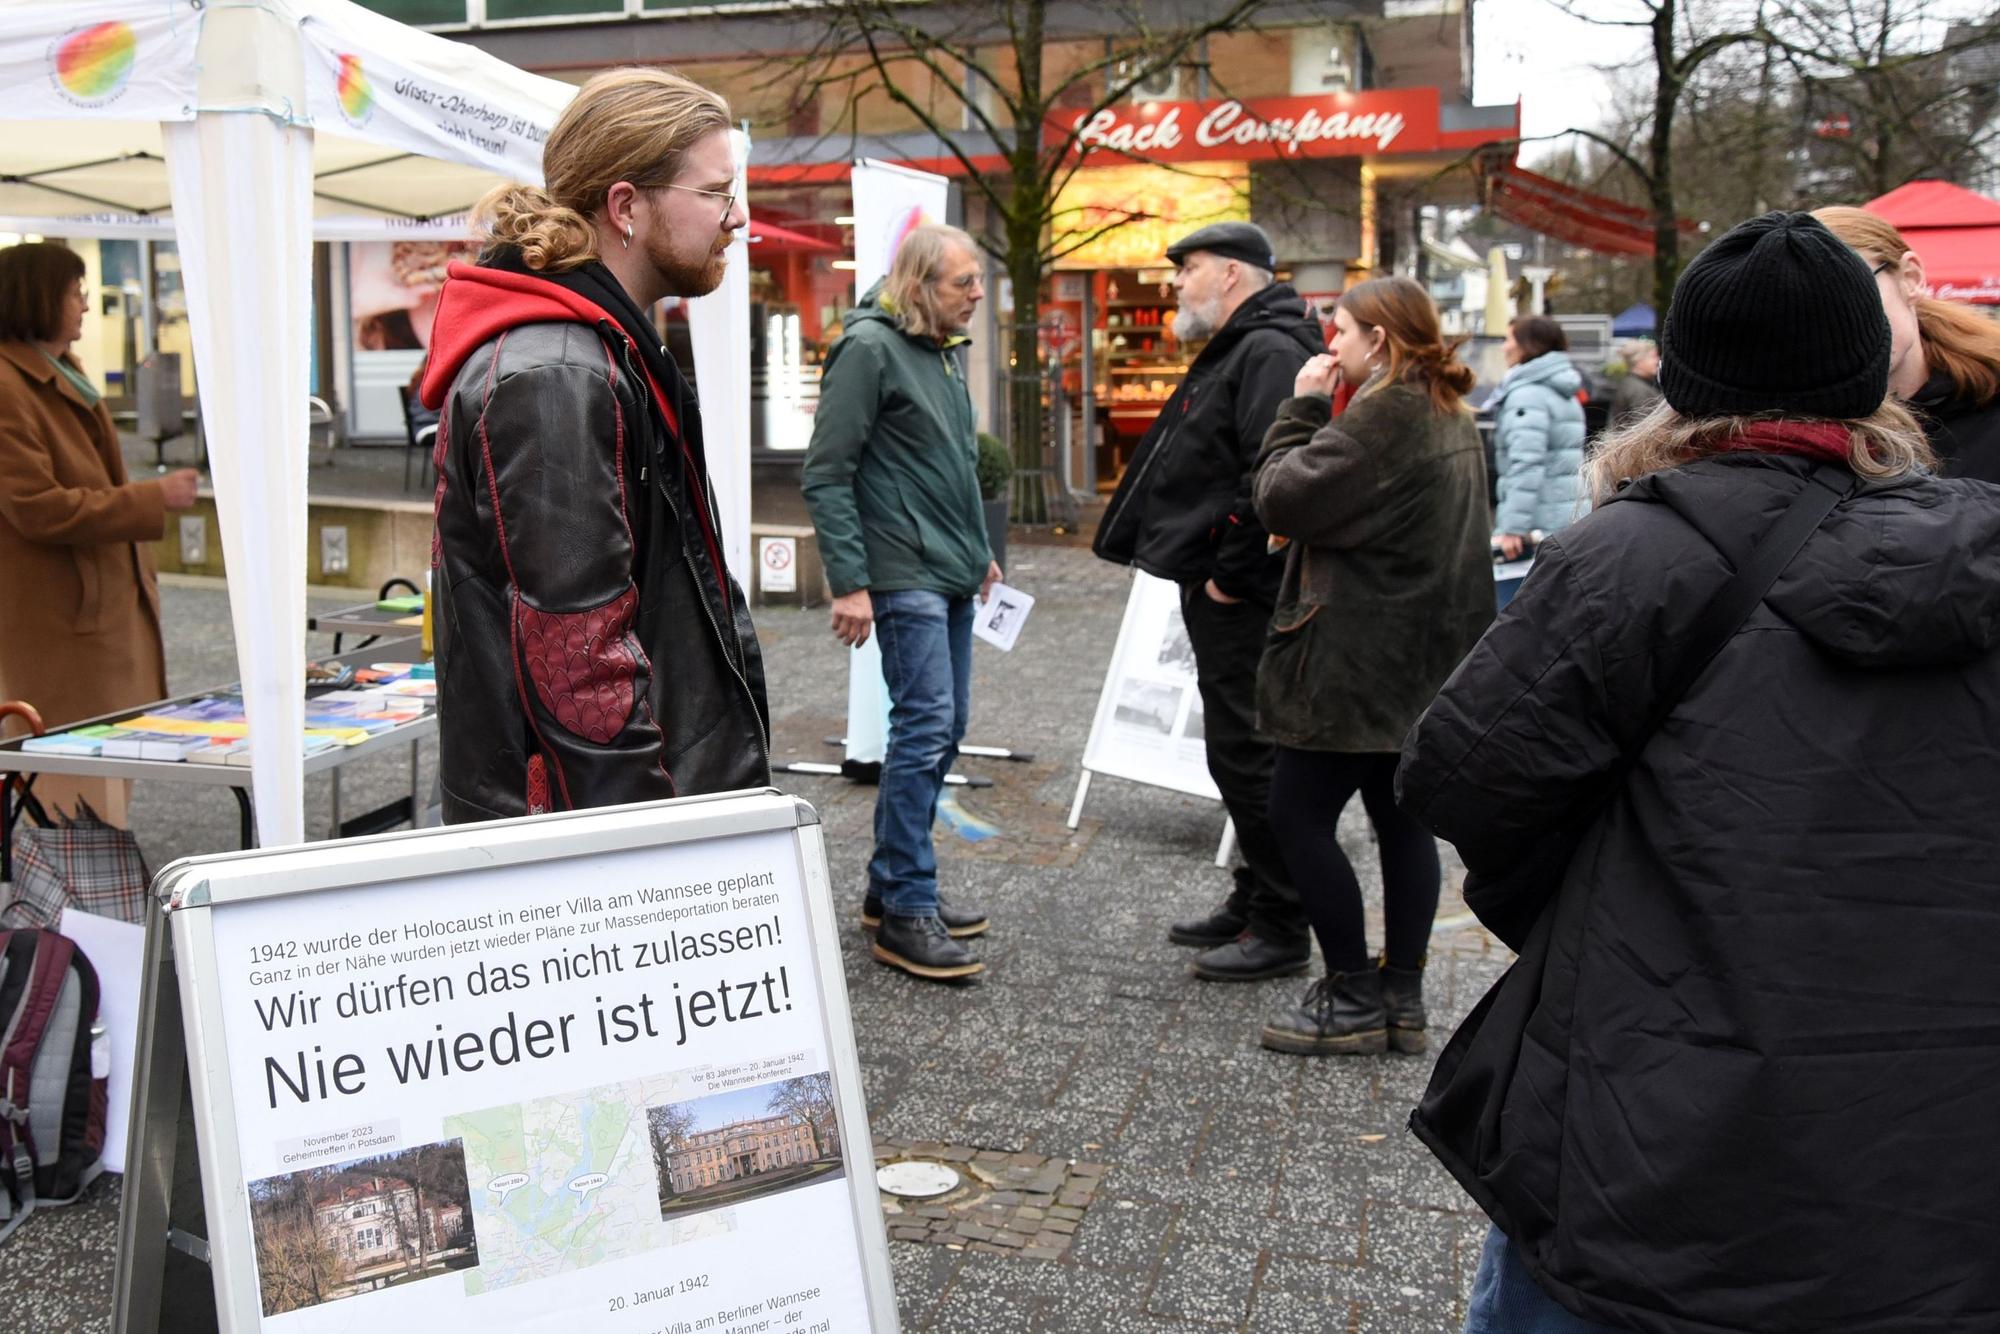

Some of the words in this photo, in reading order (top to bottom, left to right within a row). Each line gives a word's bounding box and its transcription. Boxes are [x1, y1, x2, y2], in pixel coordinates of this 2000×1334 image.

[526, 121, 550, 144] bun
[1195, 100, 1406, 154] Company
[250, 940, 298, 964] 1942
[303, 932, 362, 956] wurde
[368, 927, 398, 947] der
[404, 912, 494, 941] Holocaust
[498, 908, 515, 926] in
[519, 903, 562, 923] einer
[566, 896, 604, 916] Villa
[608, 892, 634, 910] am
[637, 881, 713, 904] Wannsee
[717, 871, 775, 896] geplant
[249, 968, 293, 987] Ganz
[297, 963, 311, 979] in
[315, 958, 341, 976] der
[346, 952, 387, 971] Nähe
[391, 942, 447, 964] wurden
[449, 938, 481, 958] jetzt
[484, 929, 531, 950] wieder
[535, 923, 576, 942] Pläne
[580, 920, 601, 935] zur
[605, 900, 729, 931] Massendeportation
[732, 891, 781, 910] beraten
[255, 990, 322, 1032] Wir
[336, 974, 454, 1019] dürfen
[466, 962, 531, 997] das
[542, 943, 624, 985] nicht
[633, 915, 783, 969] zulassen!
[264, 1045, 366, 1109] Nie
[386, 1011, 575, 1085] wieder
[595, 993, 659, 1047] ist
[672, 966, 792, 1046] jetzt!
[691, 1074, 704, 1083] Vor
[705, 1071, 716, 1080] 83
[717, 1066, 741, 1078] Jahren
[749, 1062, 761, 1072] 20.
[762, 1057, 786, 1070] Januar
[787, 1052, 805, 1064] 1942
[707, 1081, 720, 1091] Die
[721, 1066, 792, 1087] Wannsee-Konferenz
[282, 1144, 346, 1164] Geheimtreffen
[347, 1141, 356, 1151] in
[357, 1134, 396, 1149] Potsdam
[303, 1132, 349, 1148] November
[352, 1126, 373, 1139] 2023
[608, 1296, 629, 1312] 20.
[632, 1284, 675, 1305] Januar
[679, 1274, 710, 1294] 1942
[665, 1321, 692, 1334] Villa
[695, 1315, 715, 1329] am
[717, 1302, 764, 1324] Berliner
[766, 1286, 821, 1310] Wannsee
[725, 1319, 771, 1334] Männer
[784, 1309, 803, 1325] der
[809, 1318, 831, 1334] mal
